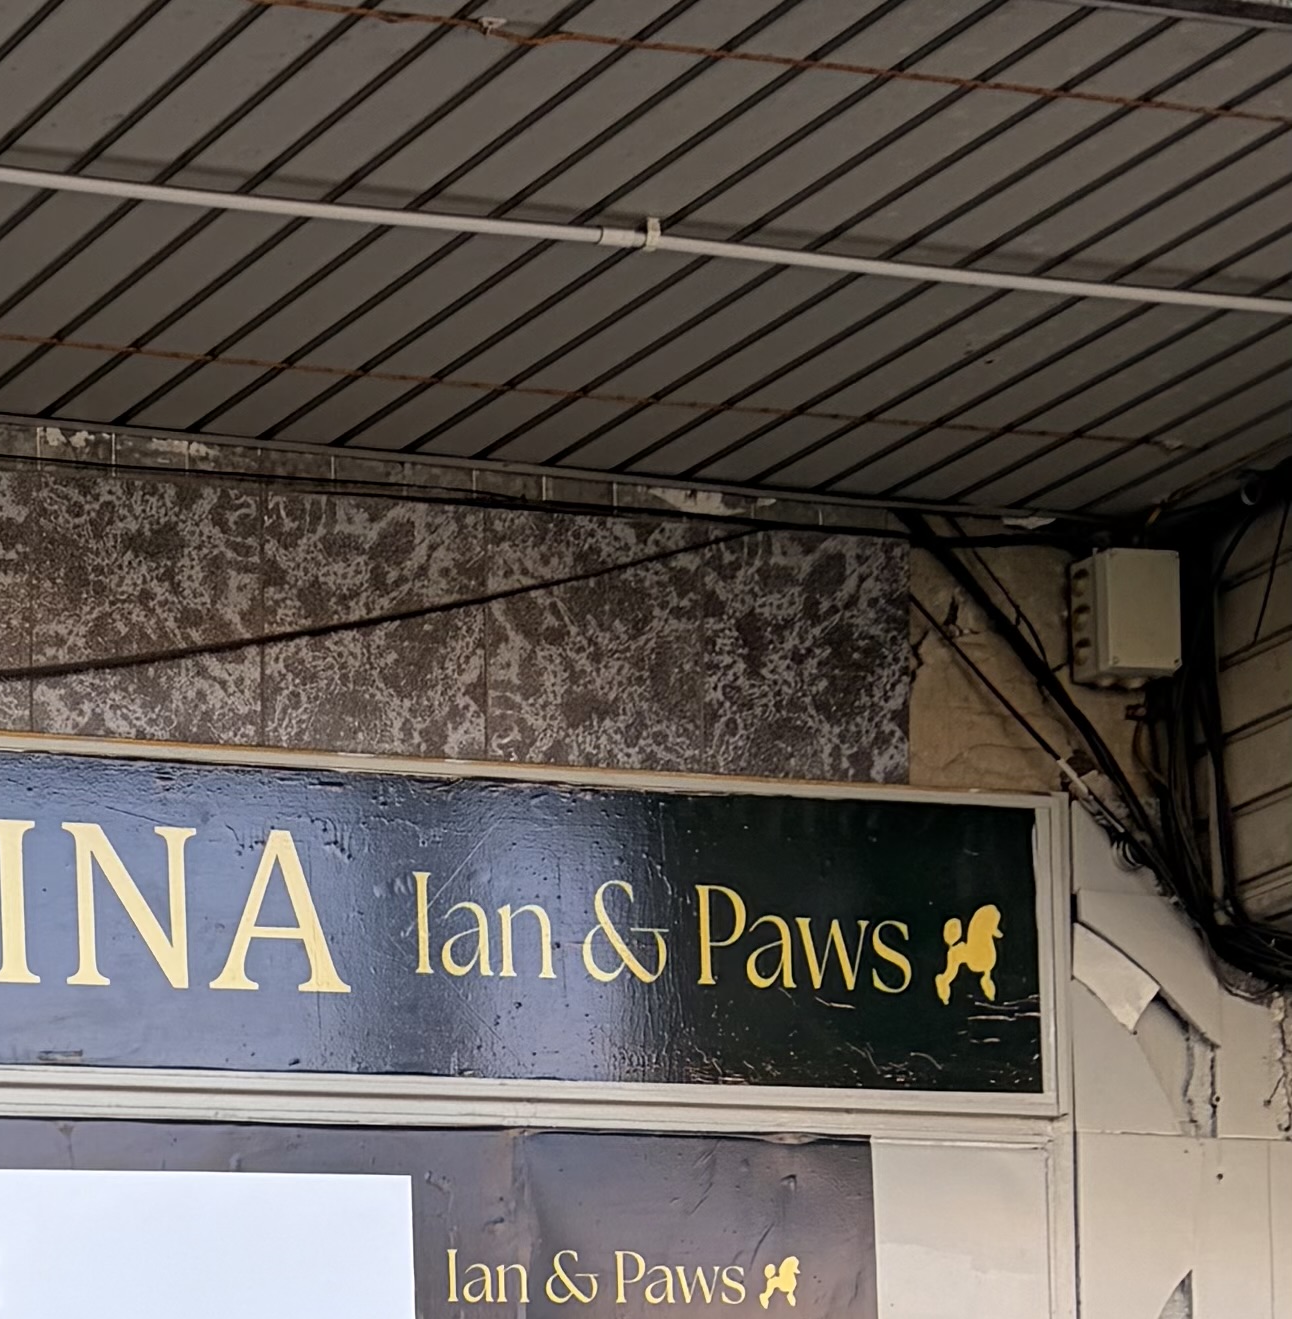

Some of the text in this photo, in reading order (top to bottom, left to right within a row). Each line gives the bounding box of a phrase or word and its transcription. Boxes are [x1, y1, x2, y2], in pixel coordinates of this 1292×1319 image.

[412, 871, 913, 994] Ian & Paws
[446, 1248, 746, 1305] Ian & Paws
